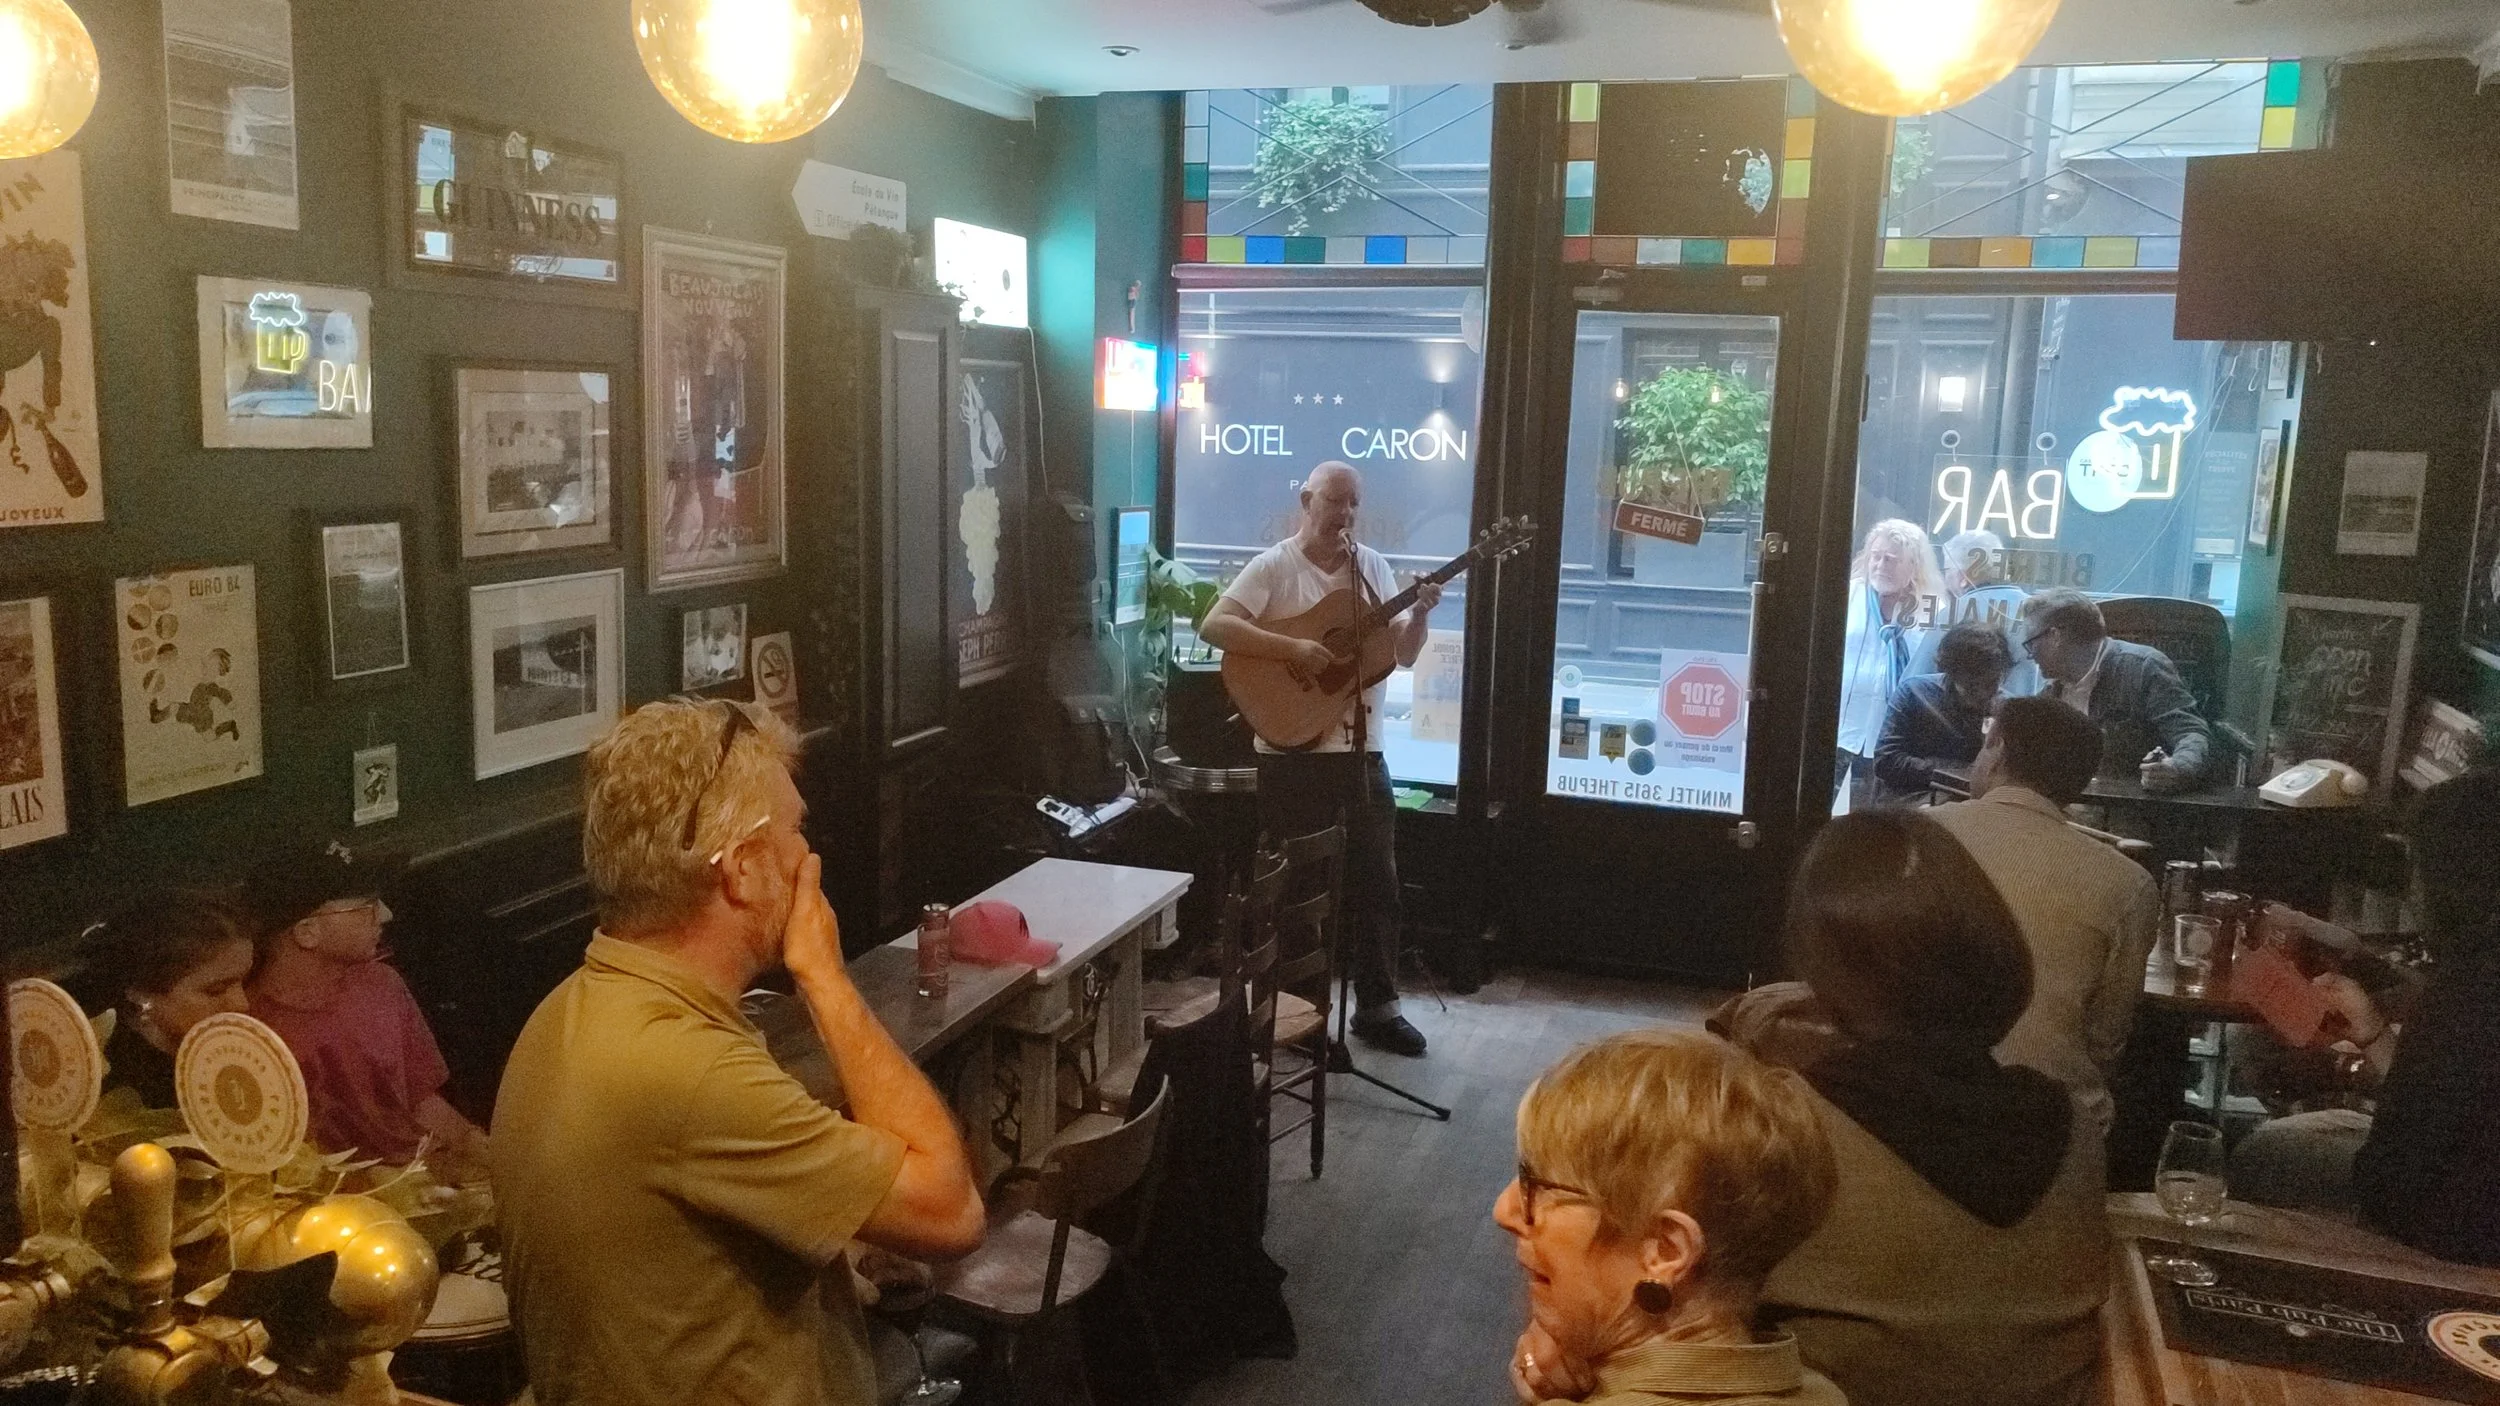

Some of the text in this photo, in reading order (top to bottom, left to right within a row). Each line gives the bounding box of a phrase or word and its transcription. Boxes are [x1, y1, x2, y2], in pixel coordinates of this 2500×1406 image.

[433, 178, 602, 246] GUINNESS
[1200, 423, 1468, 461] HOTEL CARON
[1630, 511, 1690, 538] FERMÉ
[188, 576, 222, 597] EURO
